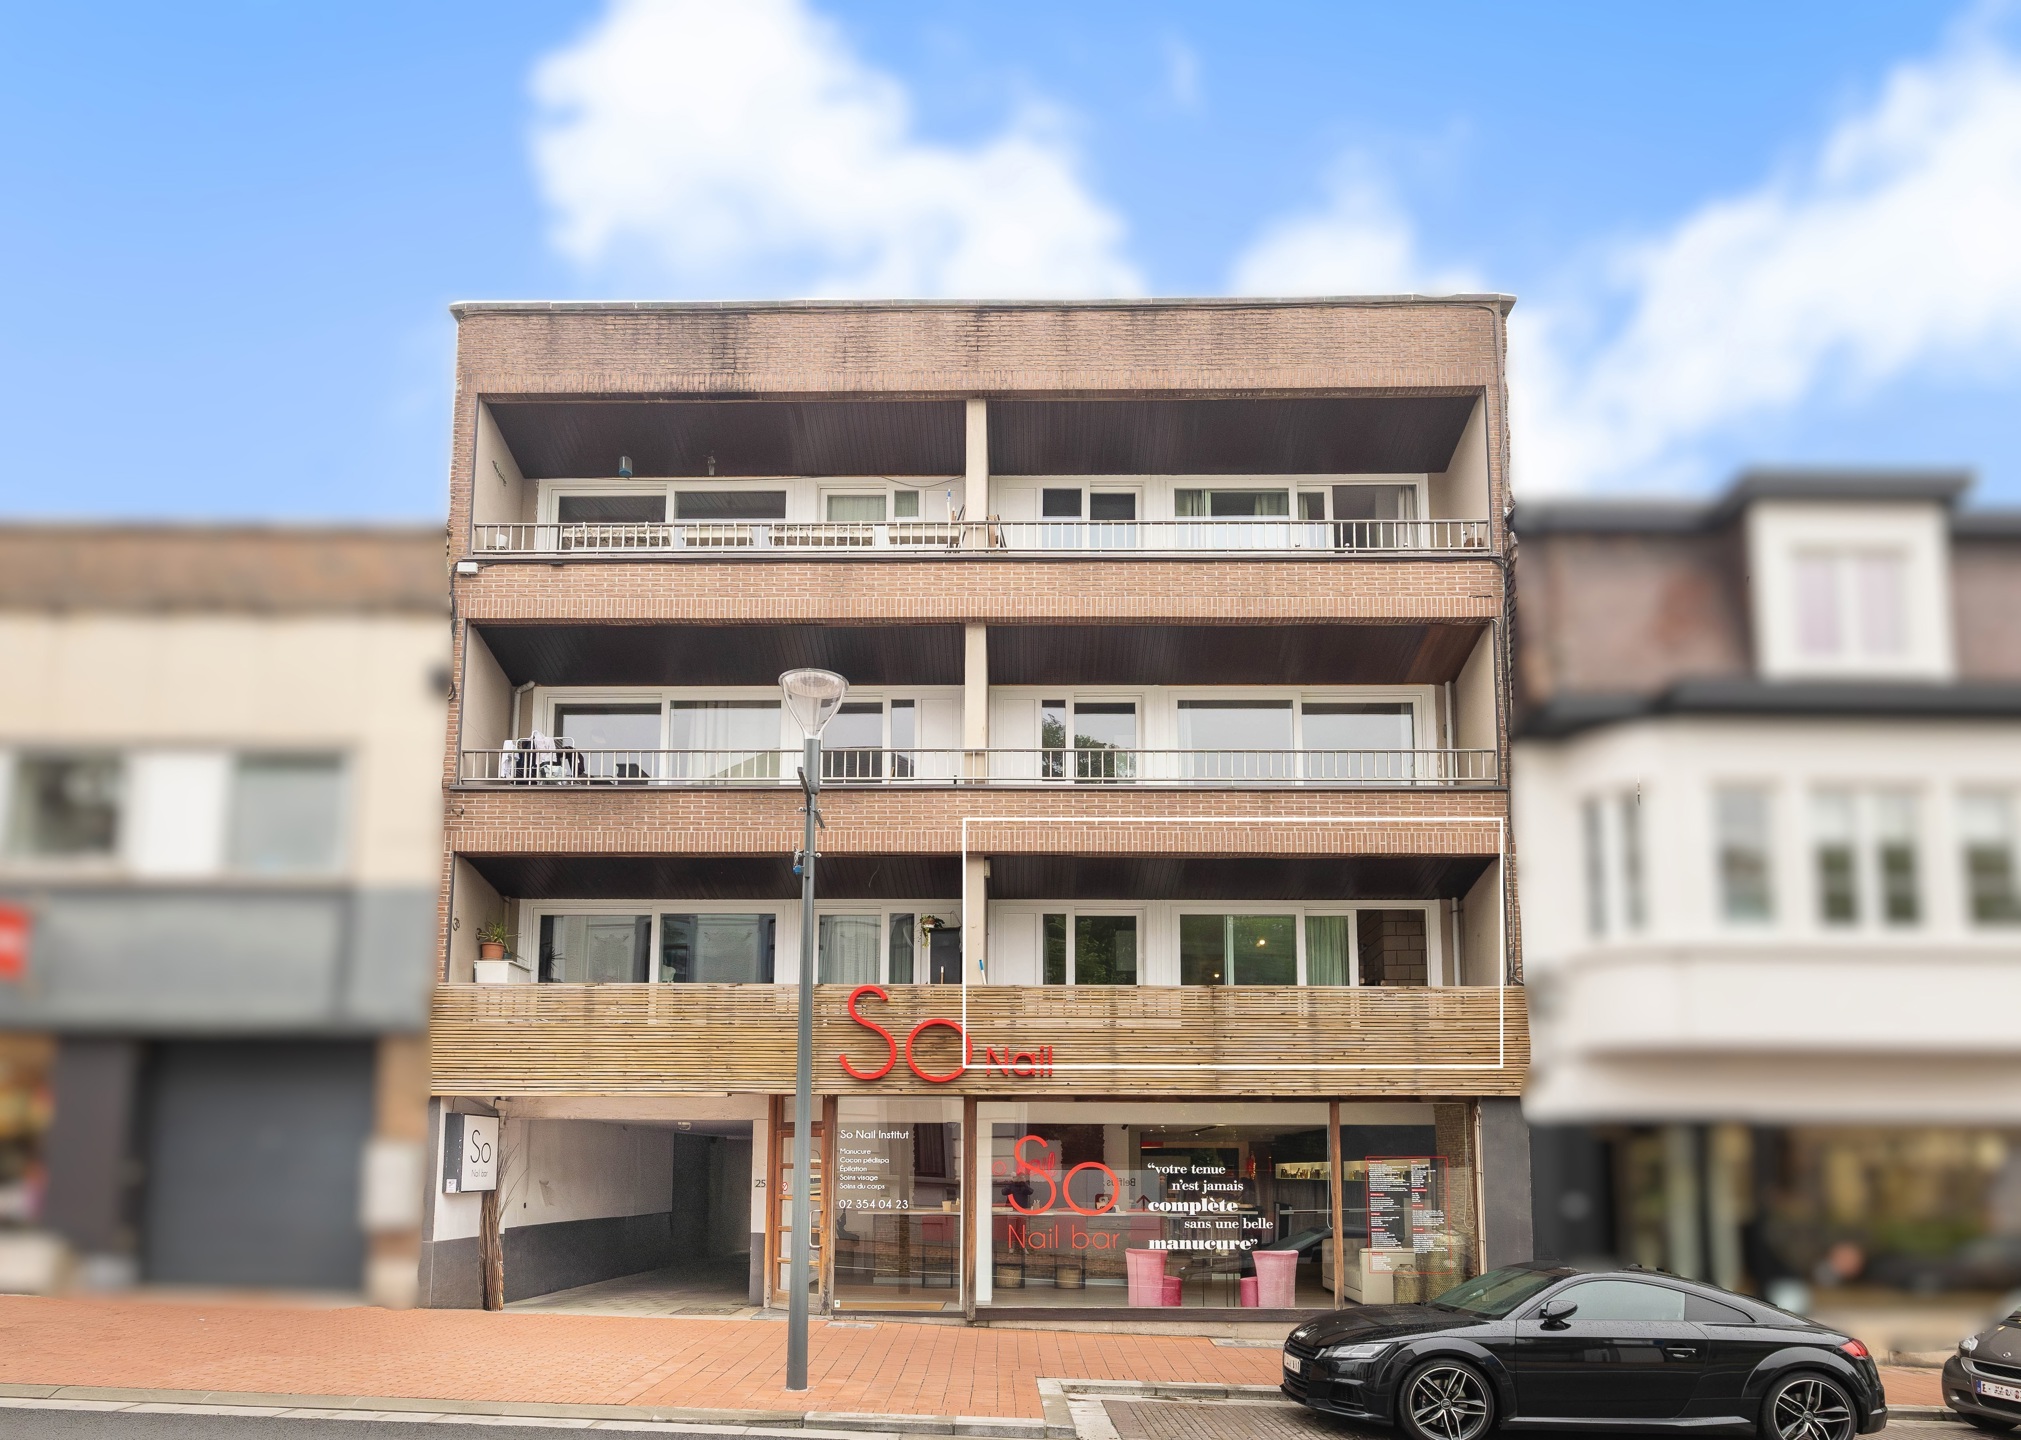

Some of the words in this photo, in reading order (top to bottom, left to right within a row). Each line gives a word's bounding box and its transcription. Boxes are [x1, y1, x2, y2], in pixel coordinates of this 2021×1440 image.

[838, 985, 973, 1083] So
[986, 1045, 1053, 1077] Nail
[840, 1129, 853, 1139] So
[856, 1130, 875, 1139] Nail
[879, 1130, 909, 1139] Institut
[470, 1129, 491, 1163] So
[840, 1156, 861, 1164] Cocon
[1007, 1134, 1120, 1216] So
[1191, 1164, 1226, 1174] tenue
[755, 1179, 766, 1188] 25
[1202, 1180, 1244, 1194] jamais
[838, 1199, 852, 1209] 02
[856, 1199, 875, 1209] 354
[878, 1199, 892, 1209] 04
[896, 1199, 909, 1209] 23
[1148, 1197, 1238, 1215] complète
[1184, 1220, 1211, 1229] sans
[1215, 1220, 1239, 1229] une
[1243, 1218, 1273, 1229] belle
[1008, 1224, 1058, 1249] Nail
[1071, 1224, 1120, 1249] bar
